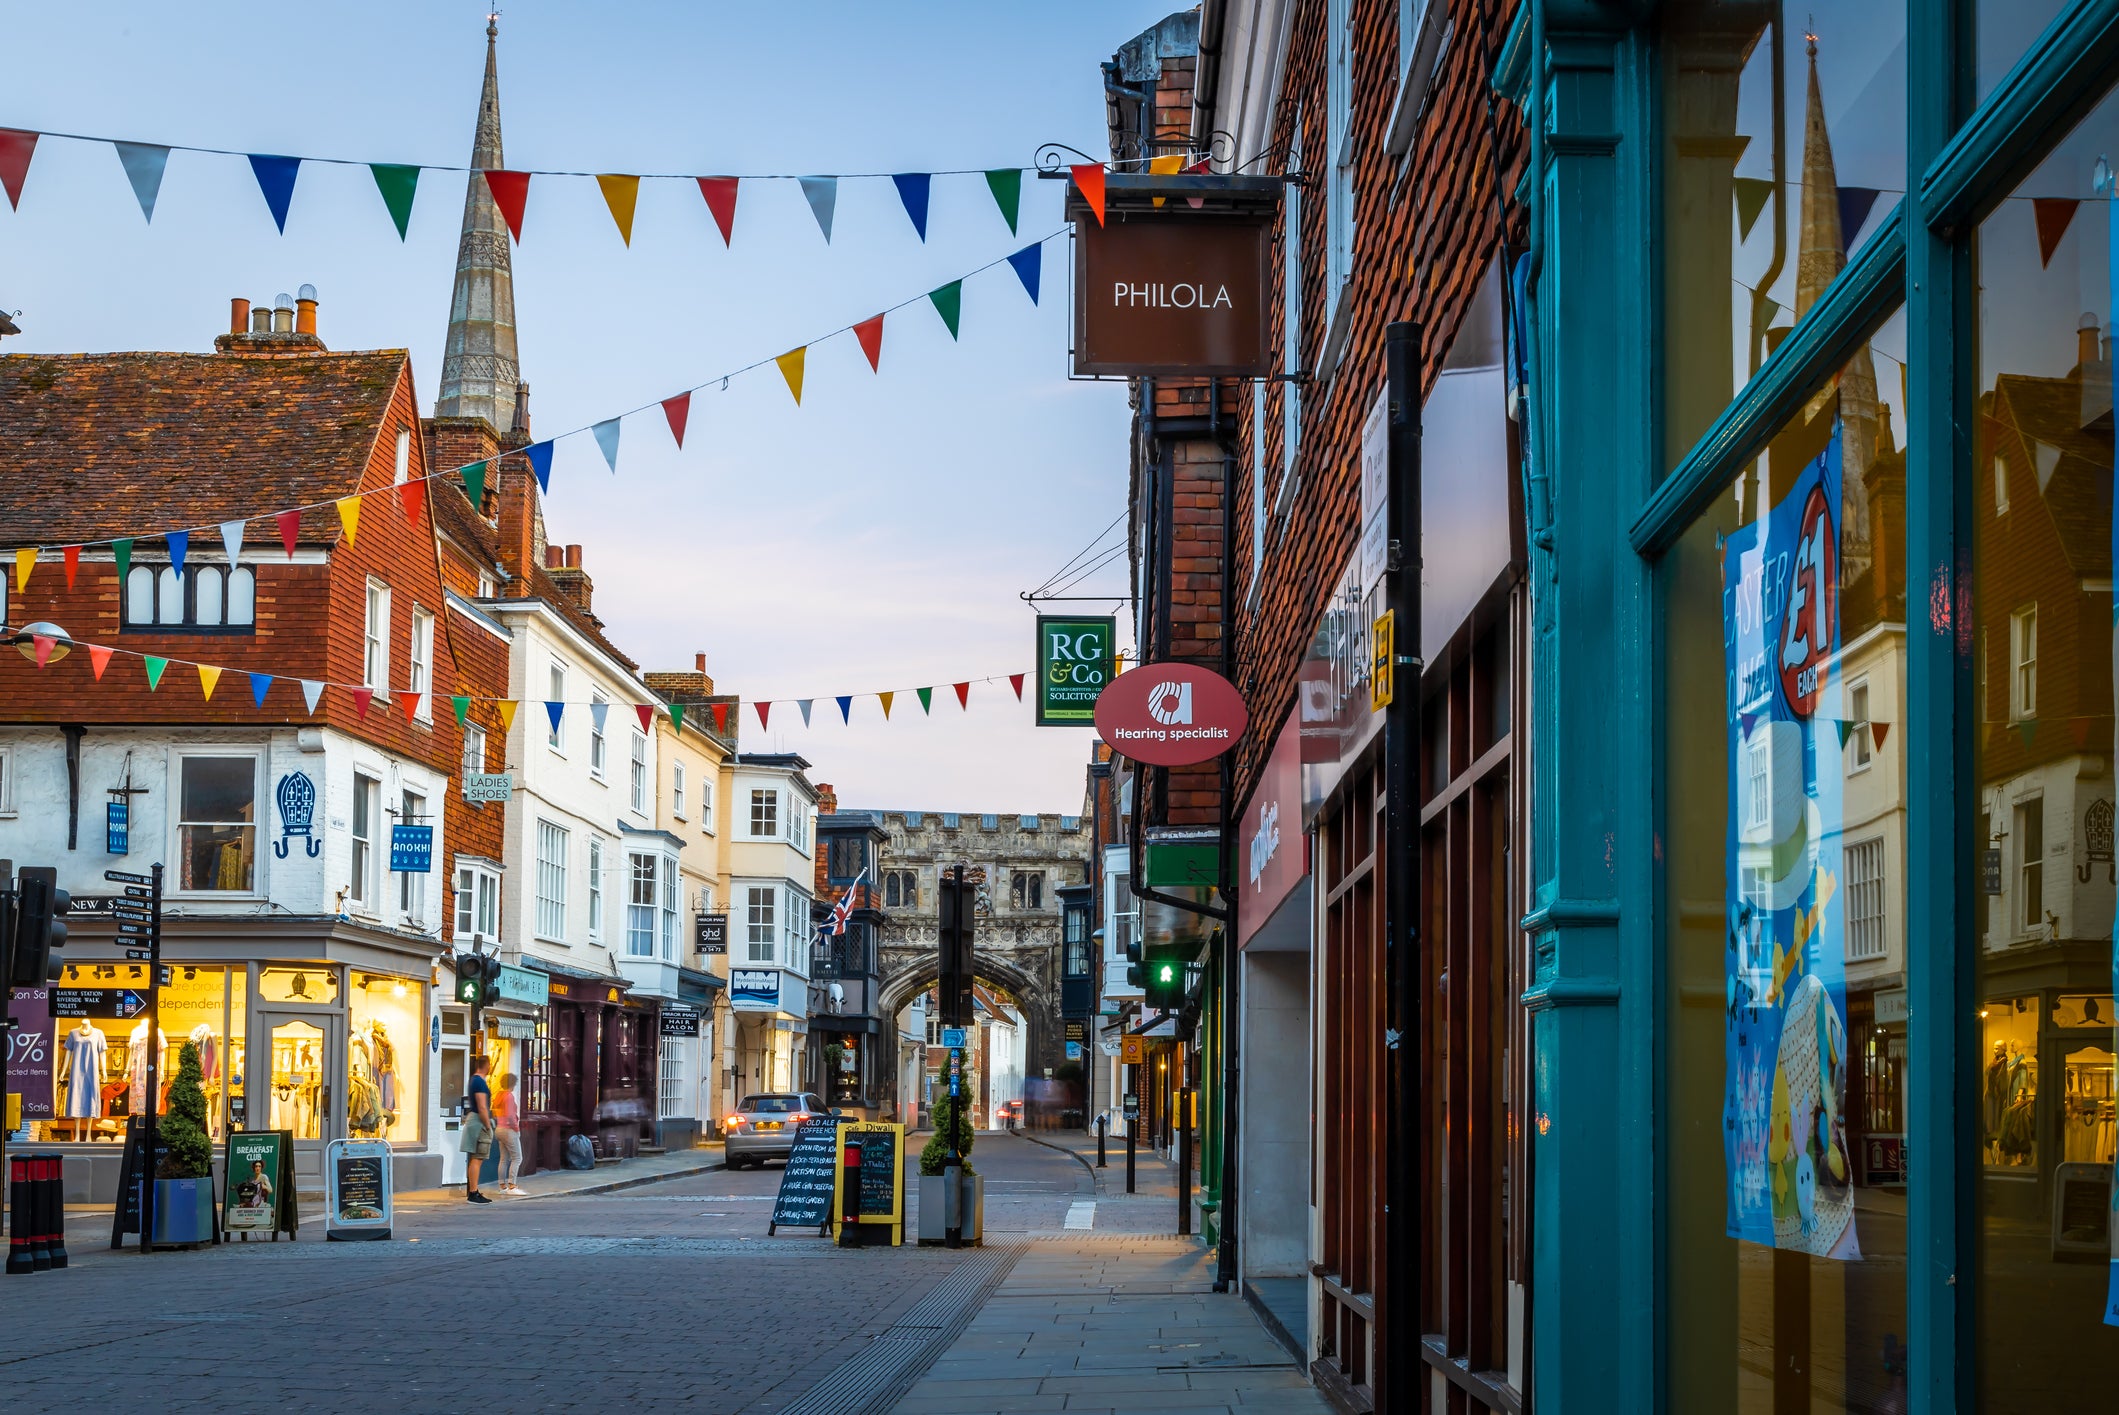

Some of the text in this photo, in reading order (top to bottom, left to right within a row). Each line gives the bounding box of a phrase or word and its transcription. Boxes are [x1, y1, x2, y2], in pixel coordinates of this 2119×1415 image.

[1114, 282, 1233, 309] PHILOLA
[1782, 511, 1828, 672] £1
[1049, 633, 1102, 660] RG
[1049, 662, 1103, 684] & Co
[1797, 662, 1819, 699] EACH
[1115, 727, 1229, 741] Hearing specialist
[471, 777, 508, 787] LADIES
[471, 789, 507, 799] SHOES
[393, 843, 431, 852] ANOKHI
[71, 900, 98, 909] NEW
[702, 927, 720, 940] ghd
[733, 971, 778, 990] MM
[33, 990, 49, 999] Sal
[158, 997, 224, 1010] dependent
[6, 1067, 28, 1075] ected
[28, 1103, 49, 1112] Sale
[865, 1123, 893, 1132] Diwali
[236, 1145, 274, 1154] BREAKFAST
[246, 1153, 262, 1161] CLUB
[791, 1168, 833, 1176] ARTISAN COFFEE
[802, 1182, 813, 1190] GIN
[805, 1195, 825, 1204] GARDEN
[802, 1210, 817, 1219] STAFF
